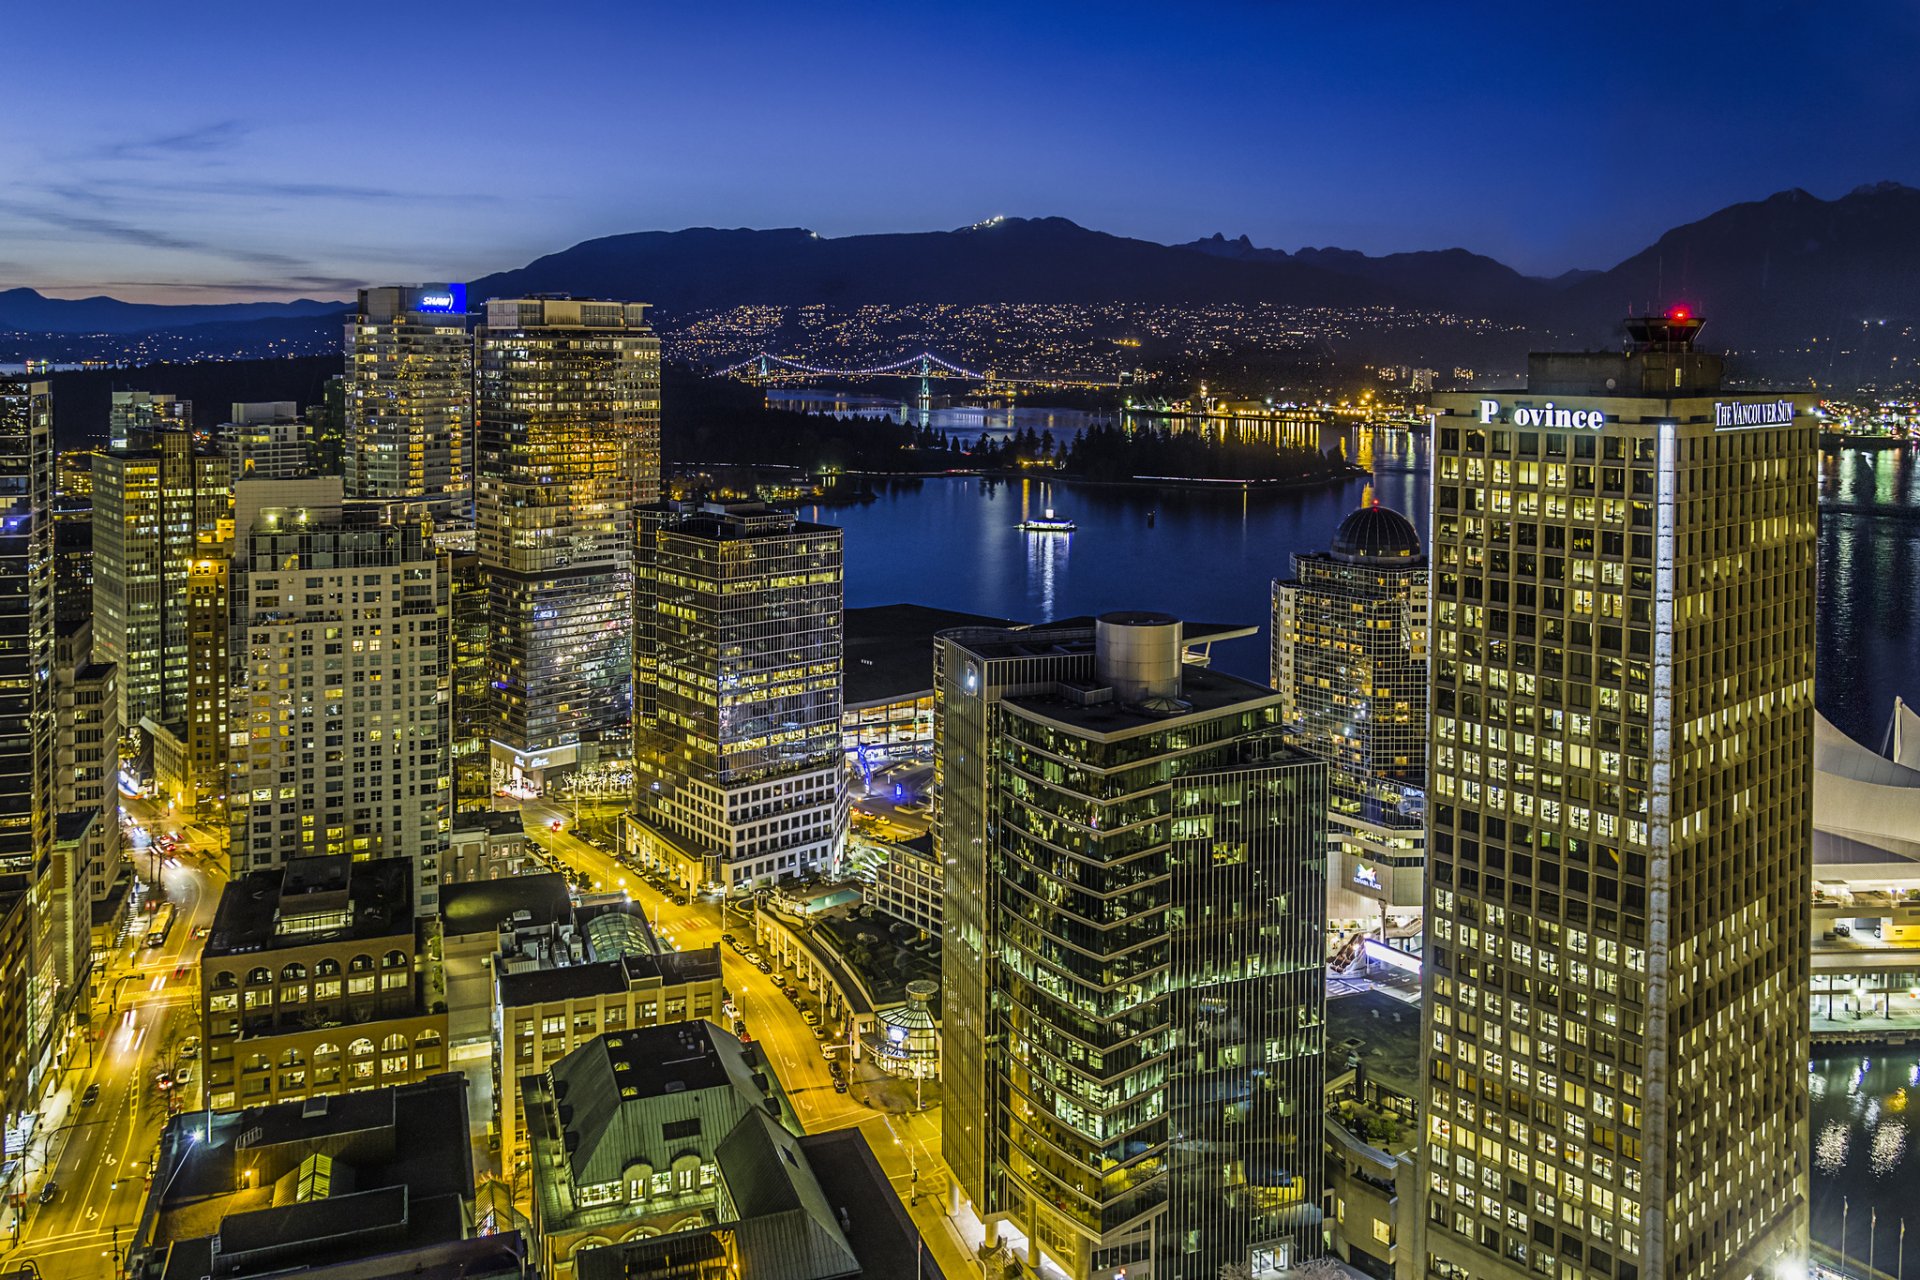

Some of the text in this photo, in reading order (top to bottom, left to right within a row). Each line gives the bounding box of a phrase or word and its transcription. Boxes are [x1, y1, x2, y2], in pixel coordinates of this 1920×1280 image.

[1479, 399, 1604, 430] Povince
[1732, 402, 1777, 425] VANCOUVER
[1778, 399, 1793, 421] SUN
